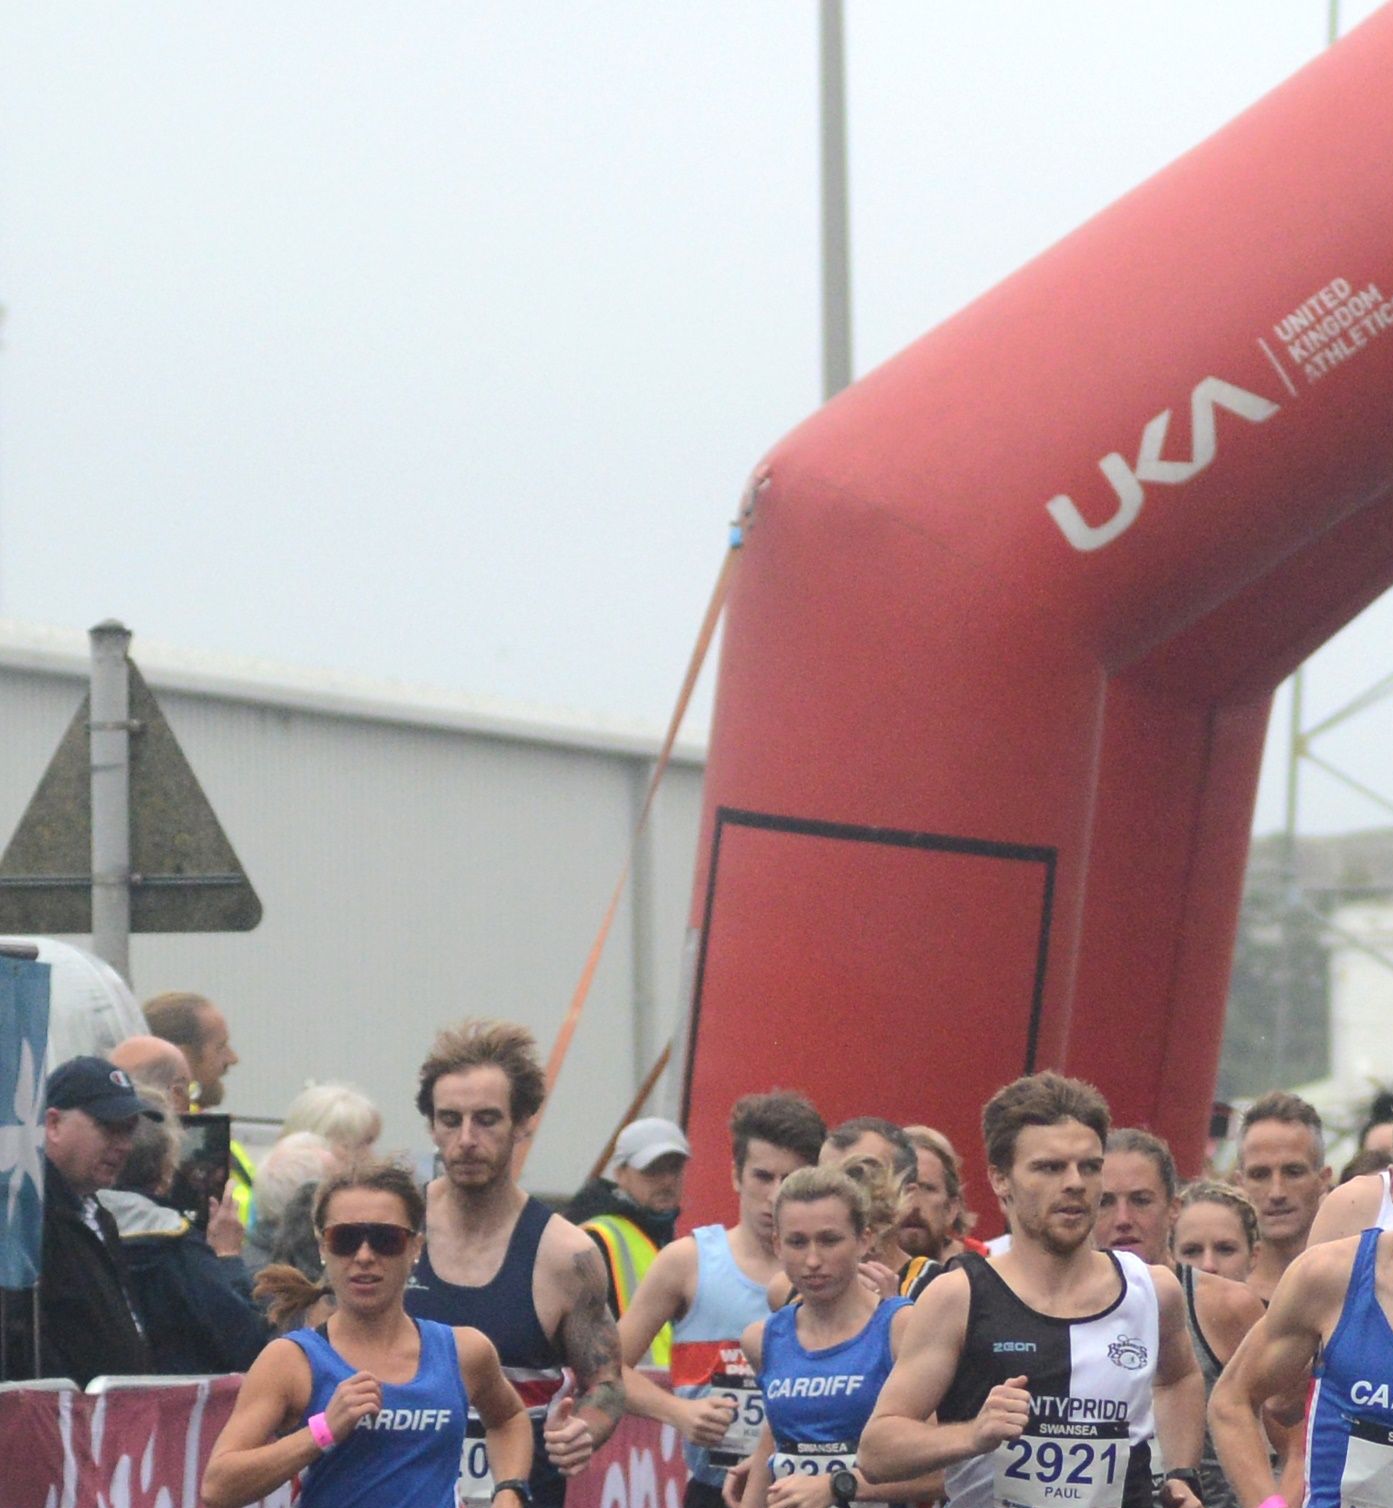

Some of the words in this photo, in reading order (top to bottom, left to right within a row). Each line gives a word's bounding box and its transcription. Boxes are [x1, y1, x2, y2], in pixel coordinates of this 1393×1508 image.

[1273, 276, 1352, 343] UNITED
[1288, 282, 1383, 364] KINGDOM
[1045, 374, 1281, 552] UKA
[767, 1375, 864, 1400] CARDIFF
[353, 1409, 452, 1431] ARDIFF
[1026, 1394, 1129, 1422] NTYPRIDD
[1039, 1422, 1098, 1437] SWANSEA
[797, 1442, 848, 1452] SWANSEA
[1003, 1437, 1117, 1485] 2921
[1044, 1486, 1081, 1499] PAUL
